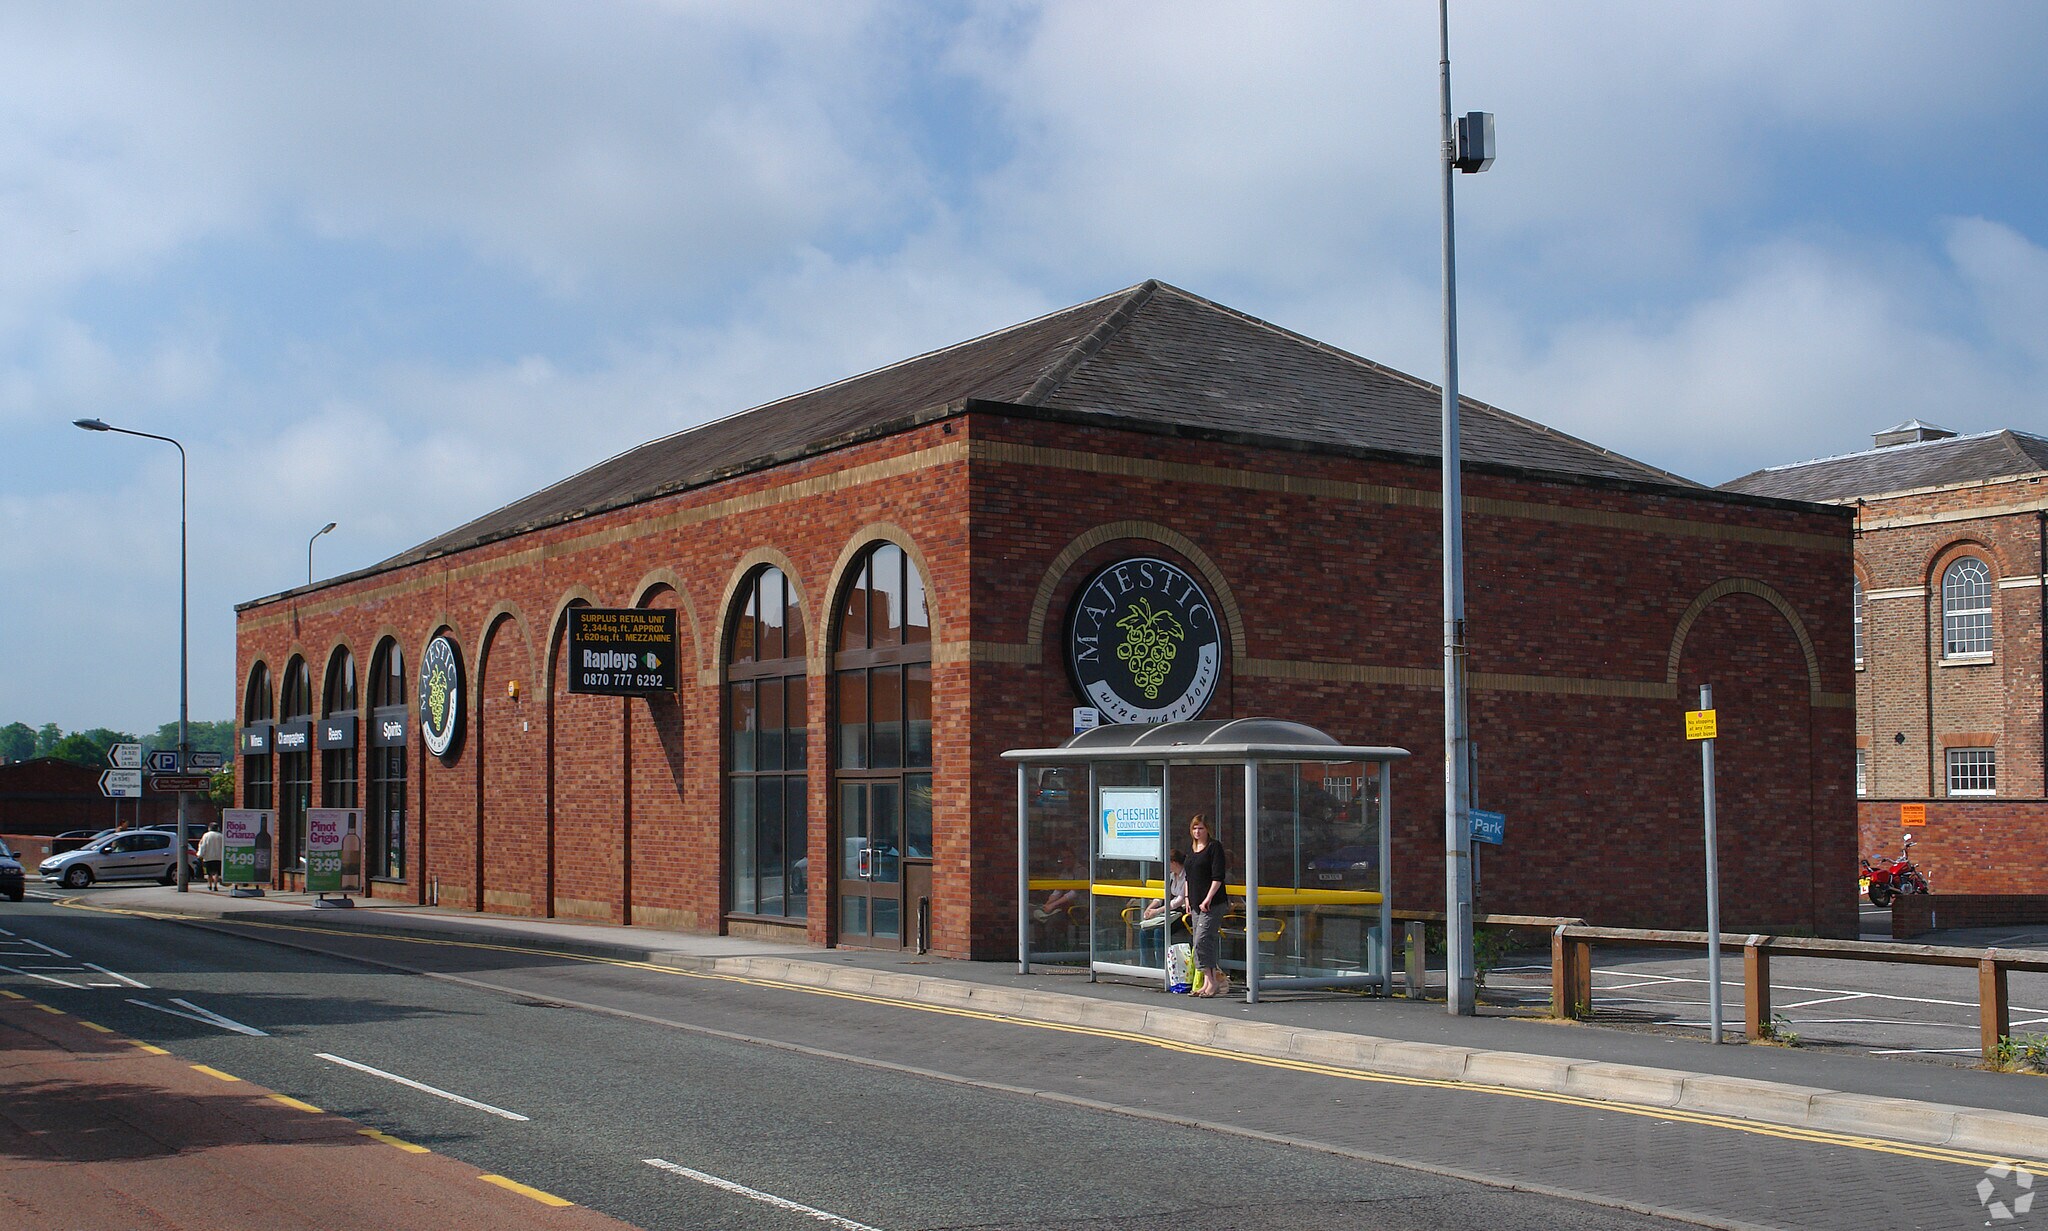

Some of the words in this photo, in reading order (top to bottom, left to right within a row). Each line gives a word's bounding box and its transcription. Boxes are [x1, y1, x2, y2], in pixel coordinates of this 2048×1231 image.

[580, 614, 617, 623] SURPLUS
[619, 614, 645, 623] RETAIL
[648, 615, 666, 624] UNIT
[1076, 562, 1211, 664] MAJESTIC
[632, 624, 664, 633] APPROX
[625, 633, 672, 642] MEZZANINE
[583, 649, 637, 671] Rapleys
[646, 652, 657, 670] R
[420, 640, 457, 710] MAJESTIC
[583, 673, 609, 686] 0870
[613, 673, 633, 686] 777
[636, 674, 663, 687] 6292
[1100, 691, 1138, 722] wine
[1147, 655, 1212, 723] warehouse
[328, 727, 343, 741] Beers
[383, 721, 402, 740] Spirits
[250, 734, 263, 747] Wines
[277, 731, 305, 747] Champagnes
[162, 755, 173, 768] P
[1116, 808, 1160, 821] CHESHIRE
[226, 821, 246, 831] Rioja
[310, 821, 337, 832] Pinot
[1116, 821, 1136, 829] COUNTY
[1137, 821, 1160, 829] COUNCIL
[1474, 818, 1502, 835] Park
[226, 830, 256, 839] Crianza
[310, 832, 339, 846] Grigio
